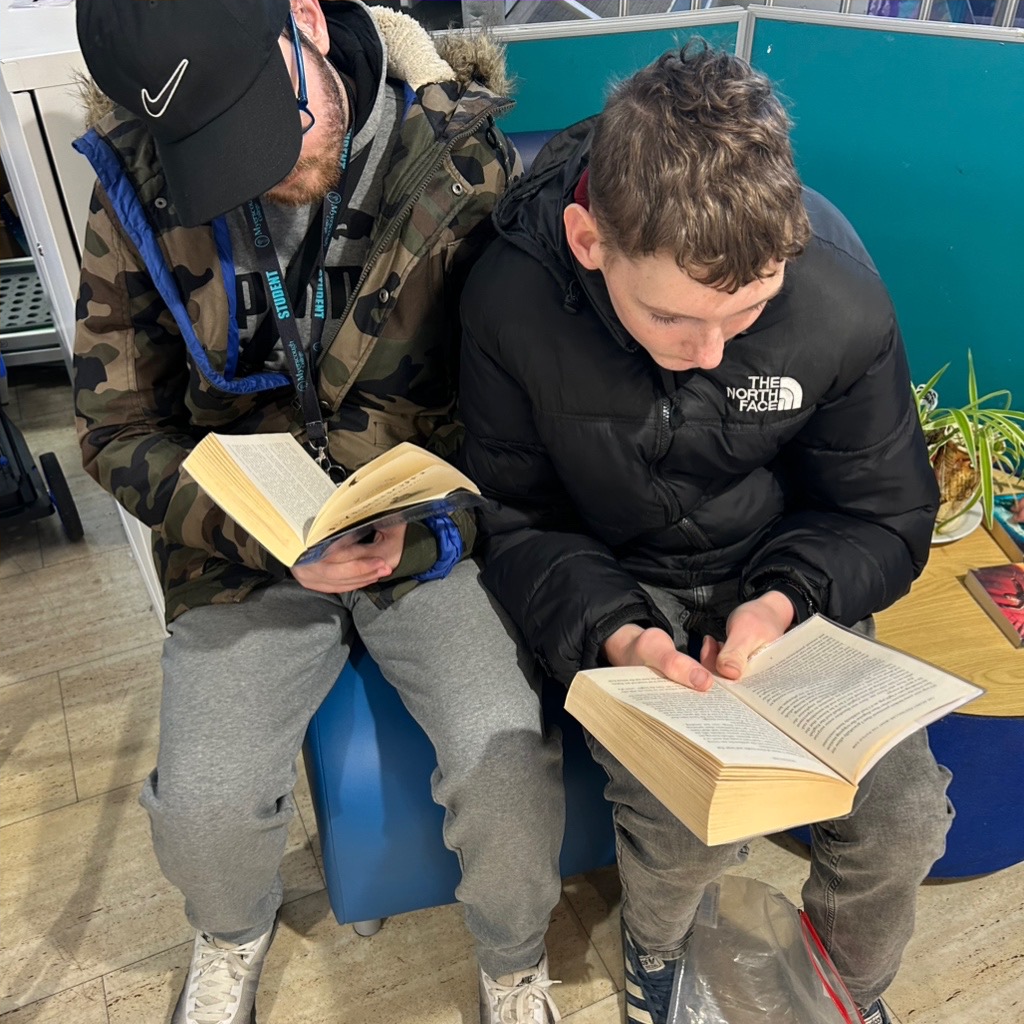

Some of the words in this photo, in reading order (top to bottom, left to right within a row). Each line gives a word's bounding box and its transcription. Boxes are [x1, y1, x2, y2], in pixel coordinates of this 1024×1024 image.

[265, 270, 292, 320] STUDENT
[748, 376, 781, 389] THE
[726, 386, 779, 403] NORTH
[739, 399, 778, 412] FACE
